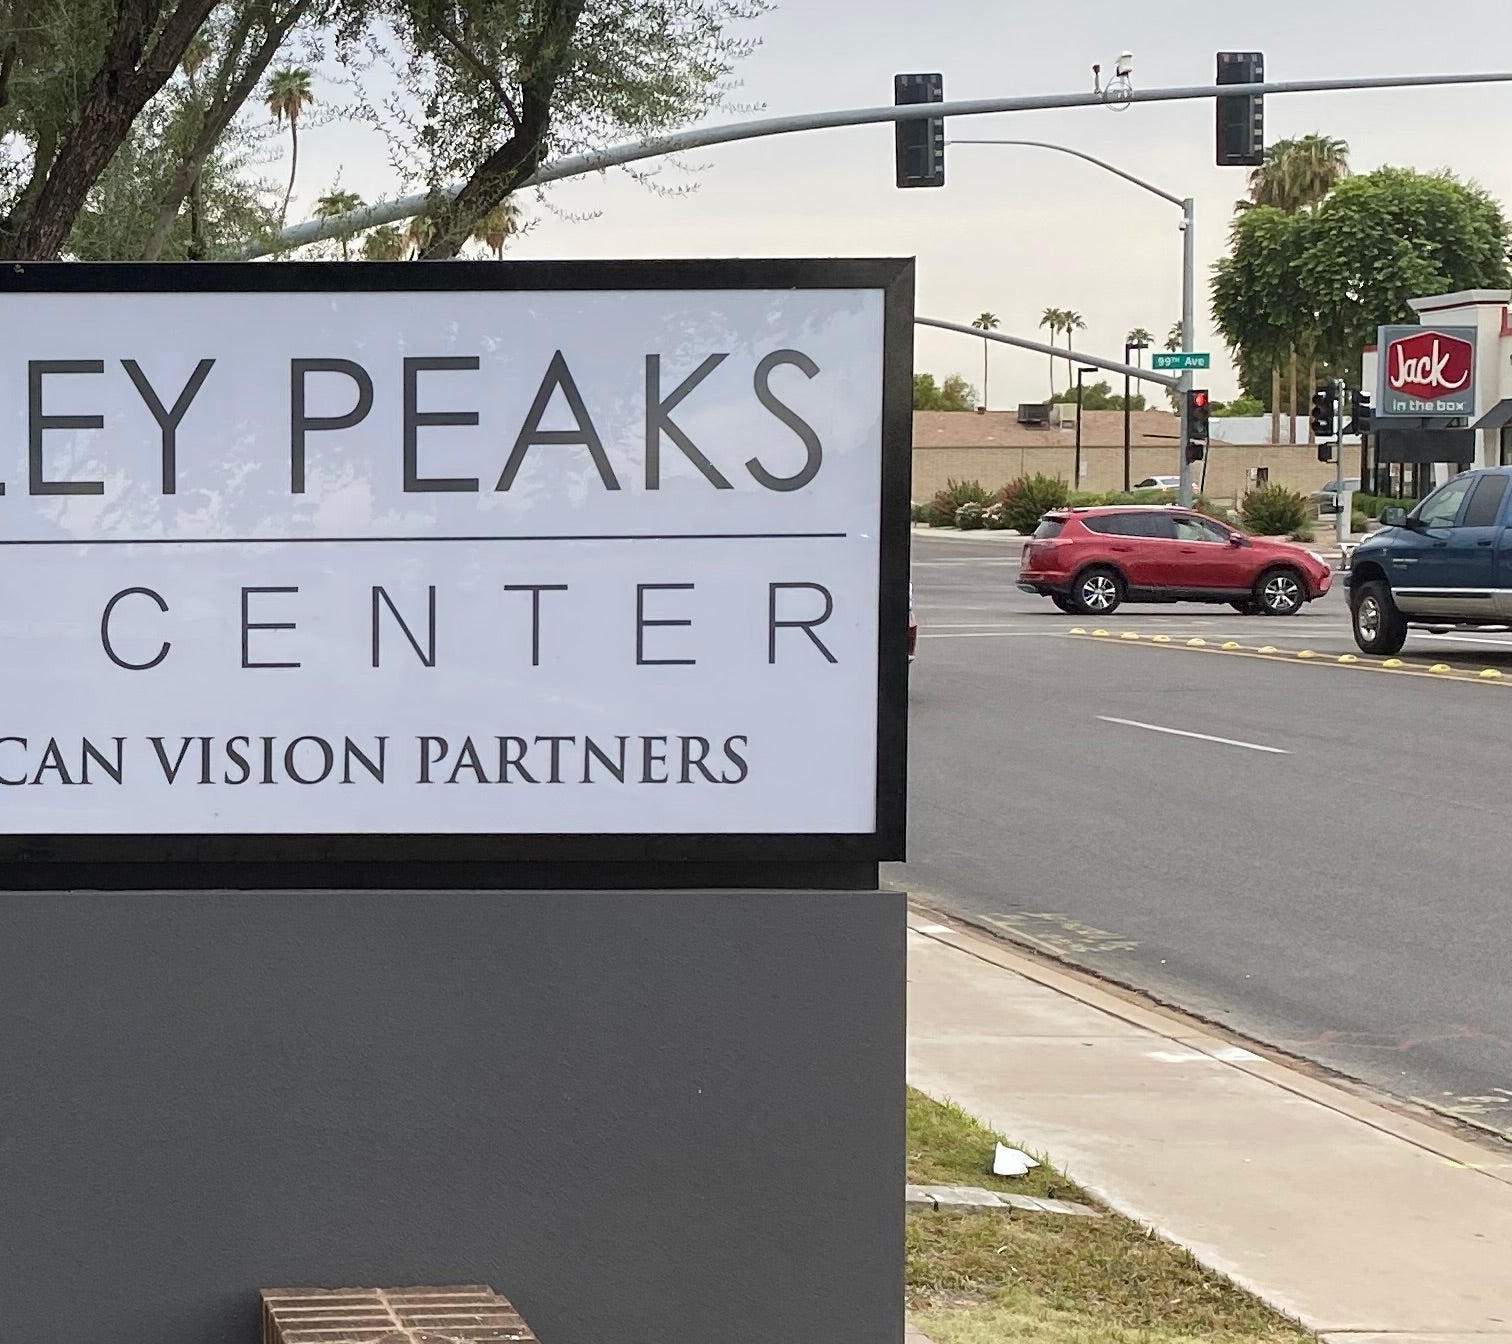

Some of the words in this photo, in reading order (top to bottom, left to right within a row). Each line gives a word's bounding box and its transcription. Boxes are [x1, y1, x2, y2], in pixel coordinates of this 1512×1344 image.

[1184, 356, 1205, 367] Ave
[1390, 339, 1468, 389] Jack
[290, 348, 823, 494] PEAKS
[1392, 399, 1407, 411] in
[1409, 399, 1434, 411] the
[1436, 399, 1464, 411] box
[100, 581, 839, 671] CENTER
[145, 735, 390, 786] VISION
[416, 734, 748, 785] PARTNERS
